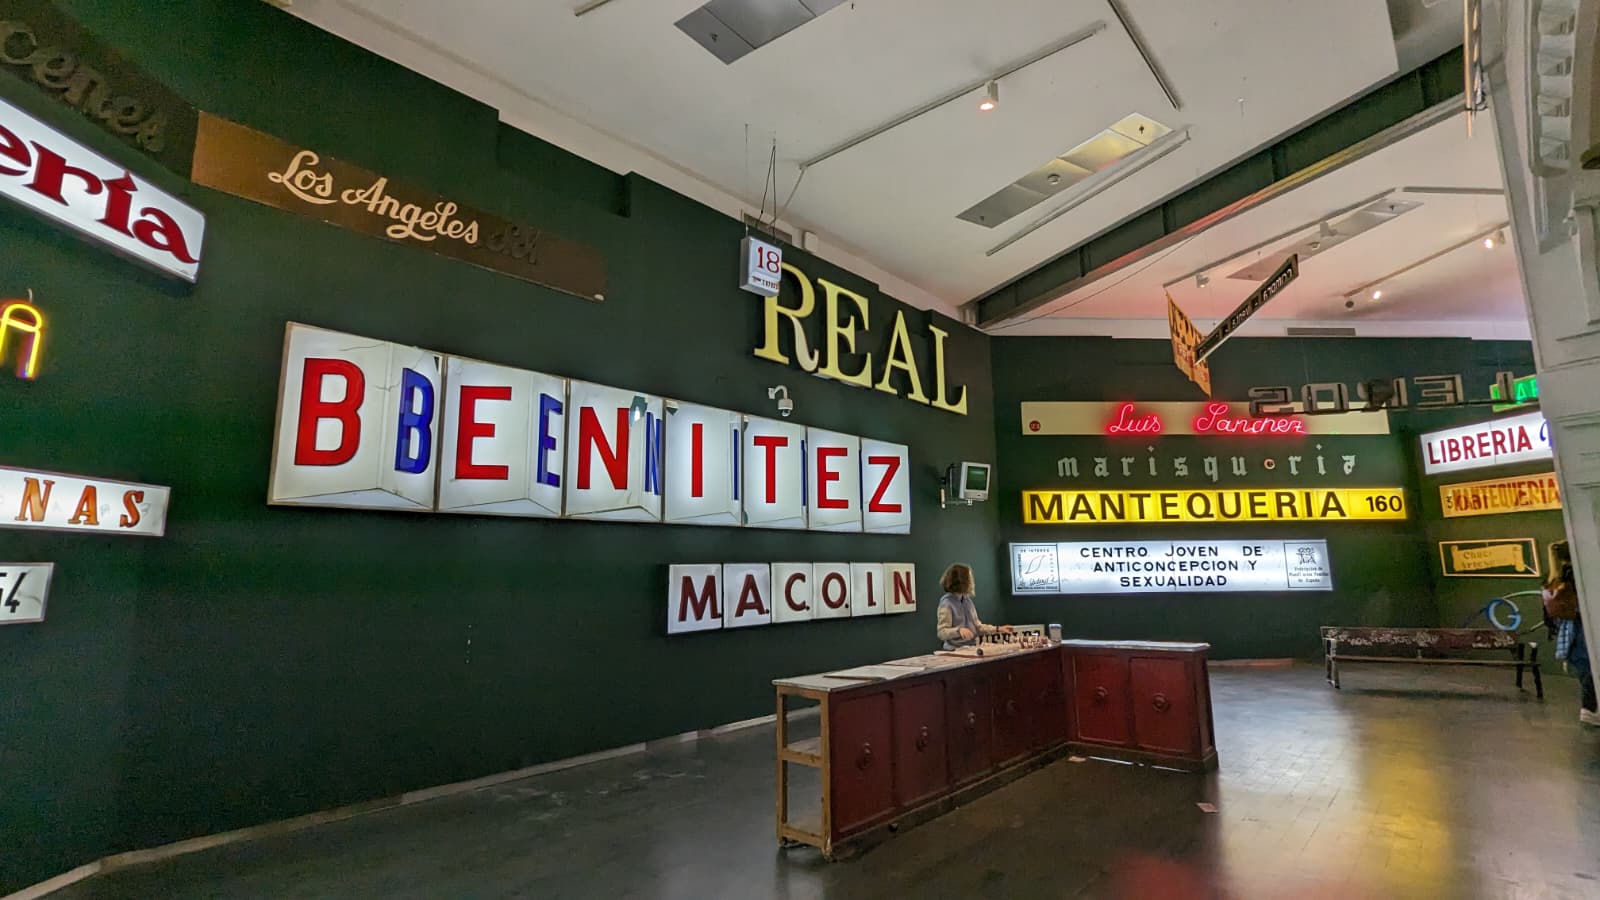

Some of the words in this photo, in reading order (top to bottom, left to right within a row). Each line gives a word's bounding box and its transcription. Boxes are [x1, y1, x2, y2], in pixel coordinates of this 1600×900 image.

[268, 150, 338, 205] Los
[341, 177, 479, 244] Angeles
[757, 246, 780, 274] 18
[753, 261, 968, 416] REAL
[1109, 403, 1161, 433] Luis
[294, 357, 903, 514] BENITEZ
[1427, 425, 1533, 466] LIBRERIA
[1057, 444, 1356, 482] marisquria
[14, 476, 145, 528] NAS
[1029, 491, 1347, 521] MANTEQUERIA
[1365, 494, 1403, 513] 160
[1080, 546, 1149, 558] CENTRO
[1165, 545, 1219, 558] JOVEN
[1242, 545, 1263, 557] DE
[1093, 560, 1239, 573] ANTICONCEPCION
[1248, 560, 1258, 571] Y
[1120, 575, 1228, 588] SEXUALIDAD
